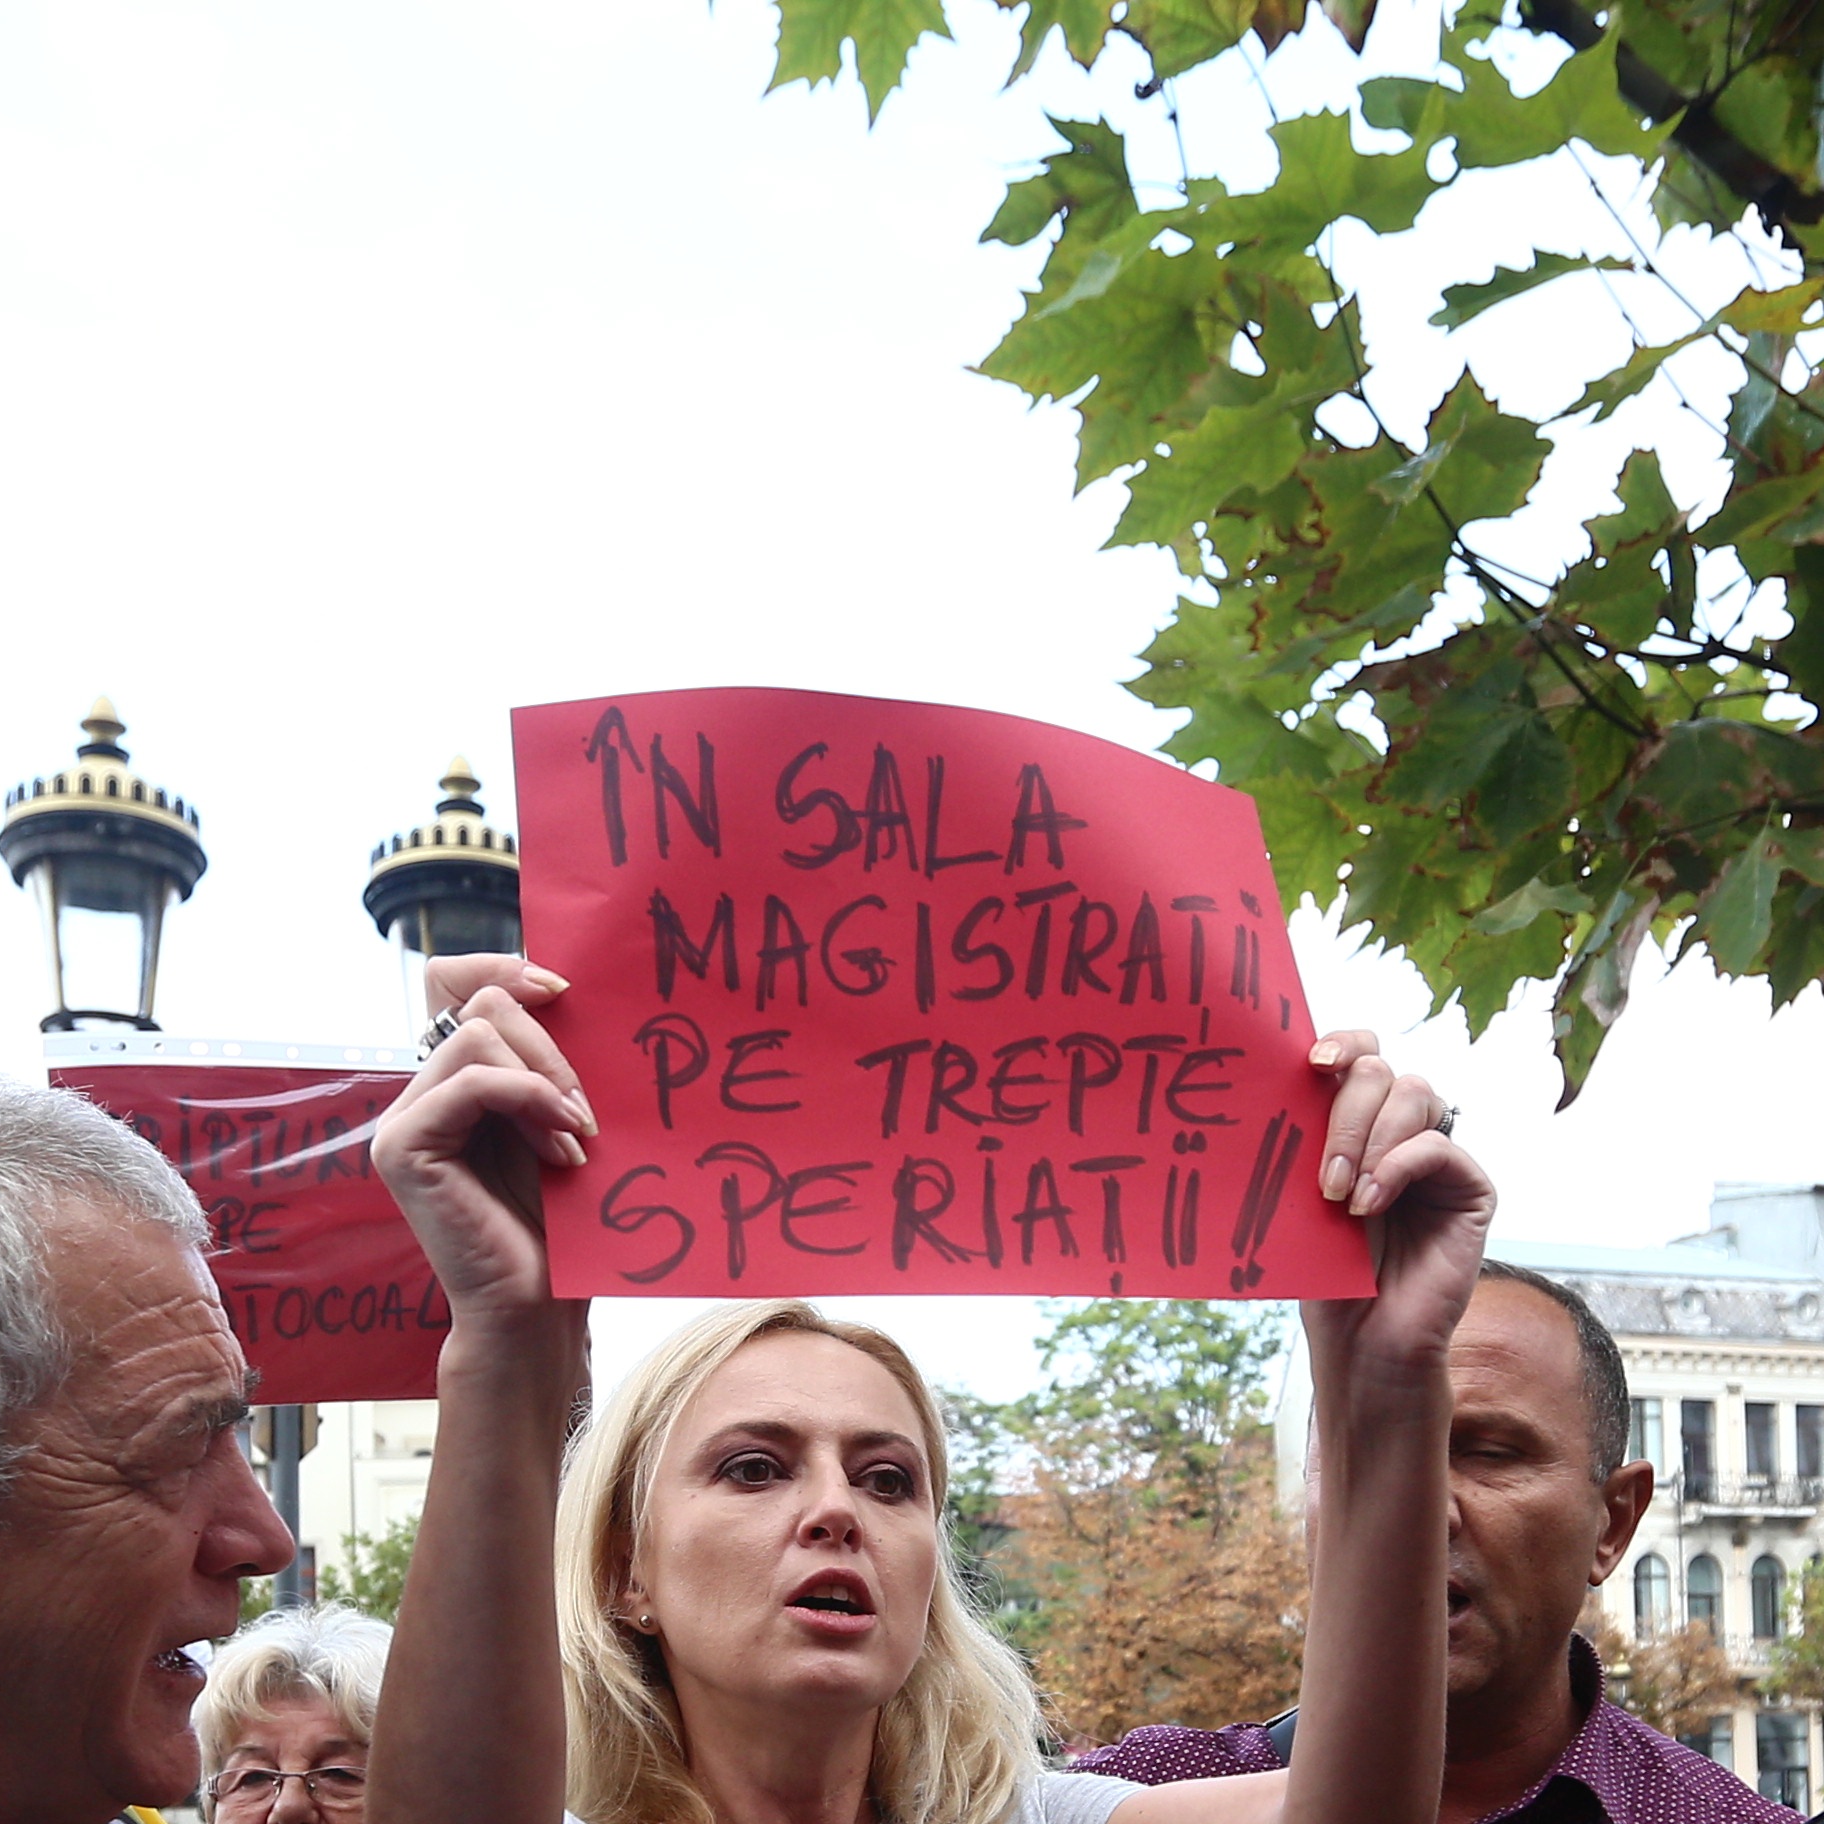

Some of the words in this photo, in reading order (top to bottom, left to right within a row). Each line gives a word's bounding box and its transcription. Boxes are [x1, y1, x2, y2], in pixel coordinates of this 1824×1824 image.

[583, 706, 722, 867] ÎN
[777, 741, 1087, 879] SALA
[631, 1012, 802, 1130] PE
[856, 1034, 1246, 1138] TREPTE
[208, 1196, 289, 1255] PE
